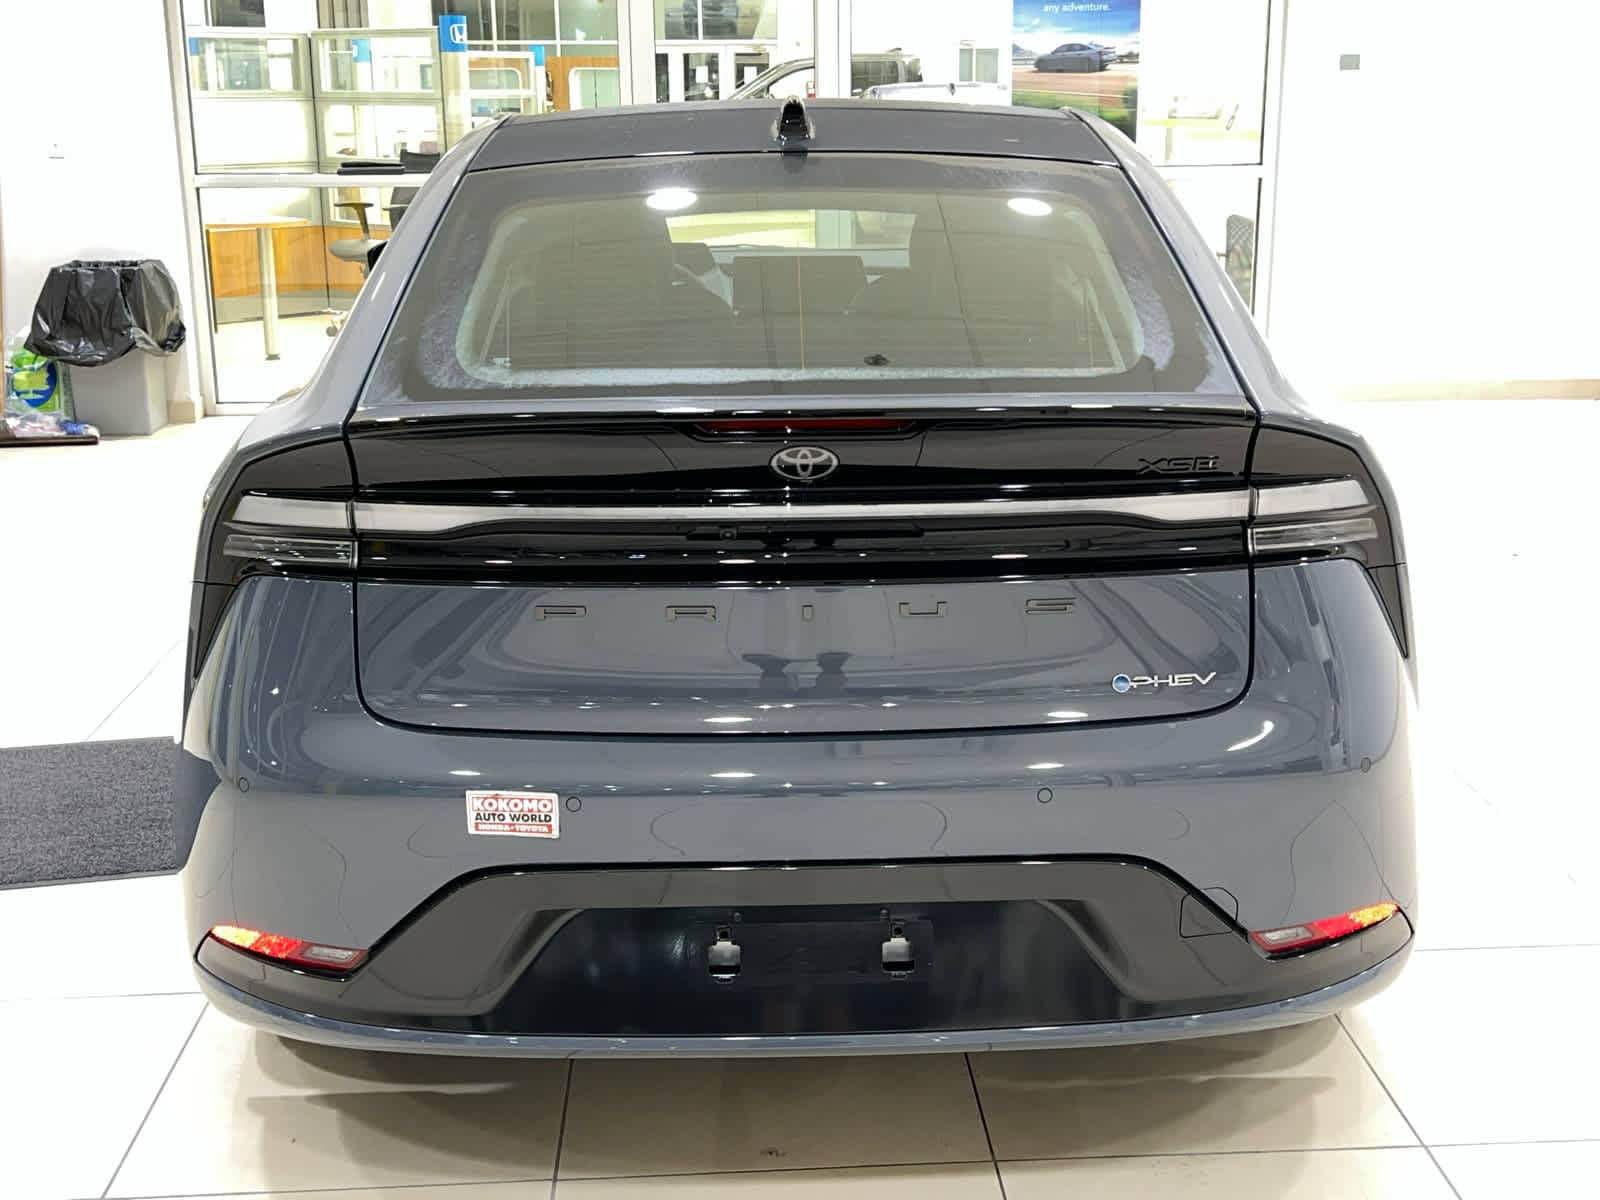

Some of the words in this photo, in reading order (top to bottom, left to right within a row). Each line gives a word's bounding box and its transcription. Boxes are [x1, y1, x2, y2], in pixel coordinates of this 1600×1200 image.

[1043, 3, 1059, 14] any
[1137, 456, 1220, 474] XSE
[1131, 672, 1216, 688] PHEV
[472, 797, 552, 812] KOKOMO
[474, 812, 506, 822] AUTO
[509, 814, 552, 823] WORLD
